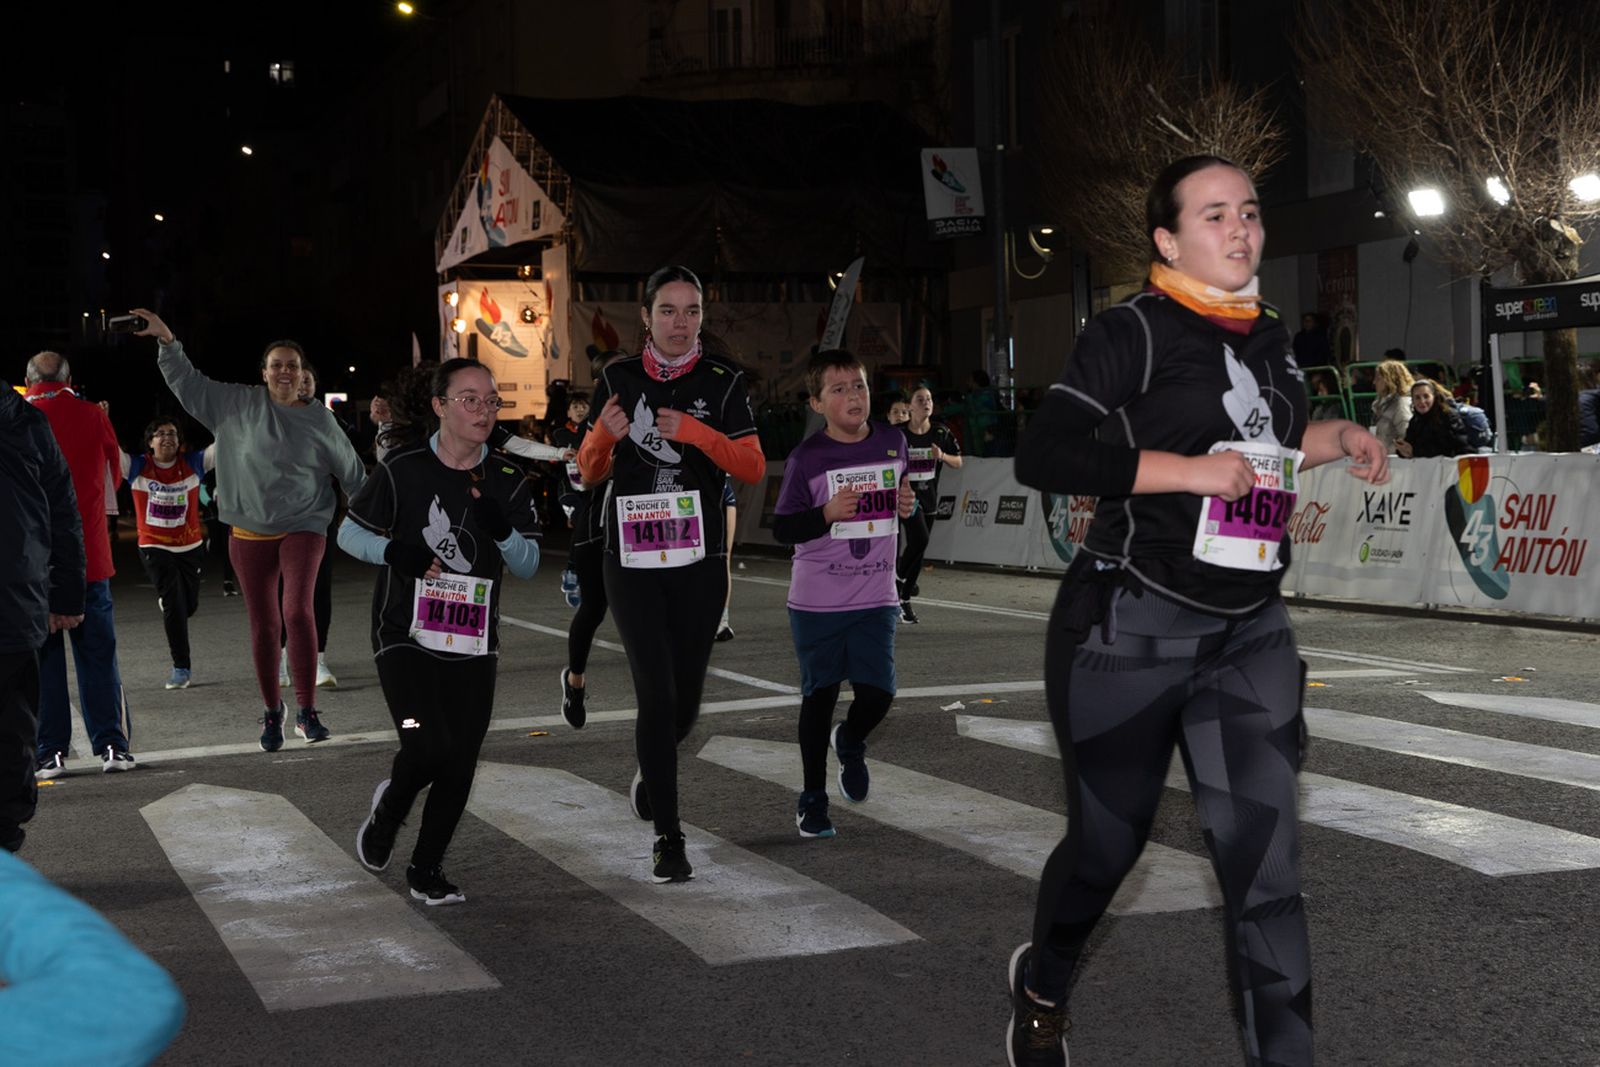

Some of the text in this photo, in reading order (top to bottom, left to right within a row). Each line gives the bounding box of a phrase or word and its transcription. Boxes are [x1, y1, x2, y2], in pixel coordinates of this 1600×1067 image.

[935, 218, 980, 227] DACIA
[489, 325, 513, 347] 43
[1244, 407, 1269, 438] 43
[641, 432, 663, 452] 43
[654, 482, 685, 492] ANTÓN
[846, 475, 868, 483] NOCHE
[868, 472, 877, 481] DE
[635, 503, 660, 511] NOCHE
[661, 501, 670, 509] DE
[856, 491, 895, 514] 306
[965, 500, 988, 514] FISIO
[1356, 491, 1417, 525] XAVE
[1500, 493, 1557, 531] SAN
[627, 512, 643, 521] SAN
[645, 508, 672, 519] ANTÓN
[964, 514, 986, 528] CLINIC
[1048, 497, 1067, 539] 43
[631, 519, 691, 544] 14162
[1459, 509, 1495, 567] 43
[436, 538, 457, 560] 43
[1492, 526, 1588, 577] ANTÓN
[425, 589, 440, 598] SAN
[435, 582, 468, 593] NOCHE DE
[427, 599, 480, 629] 14103
